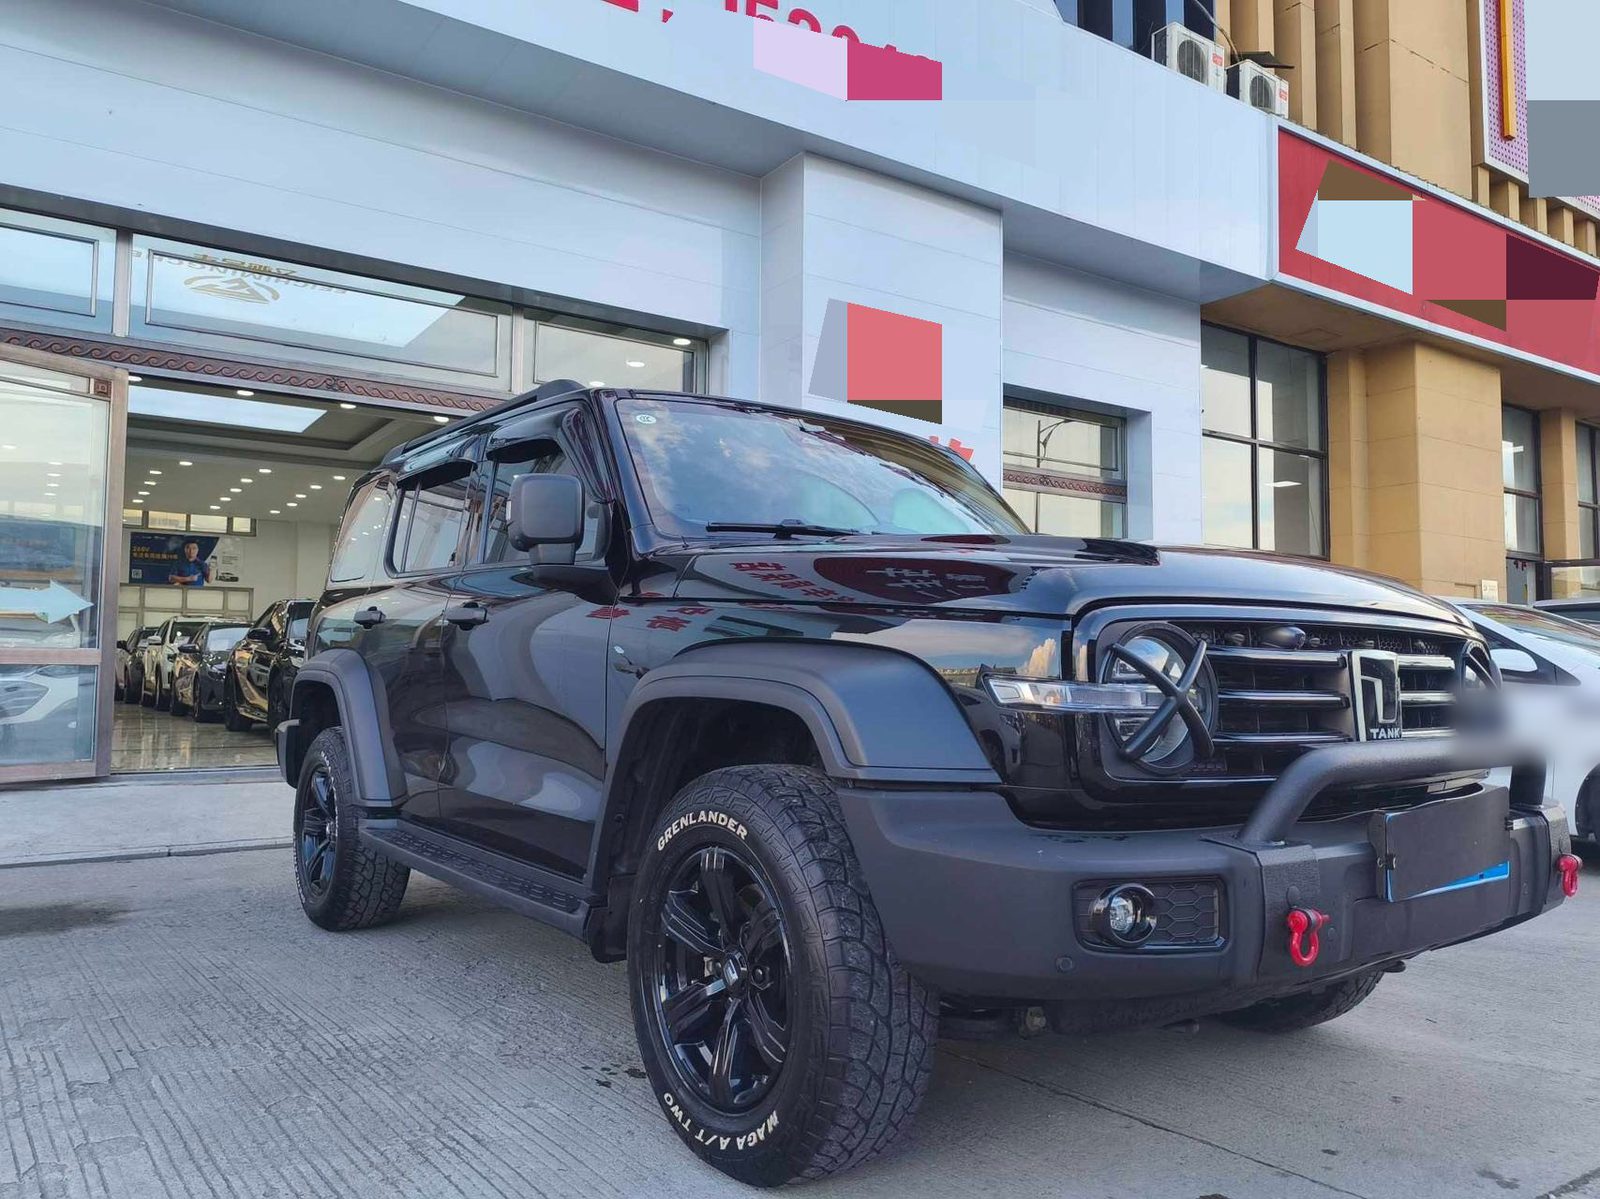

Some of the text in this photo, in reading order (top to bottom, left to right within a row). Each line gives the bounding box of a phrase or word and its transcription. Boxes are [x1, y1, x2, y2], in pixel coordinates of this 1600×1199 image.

[1369, 727, 1401, 739] TANK
[657, 810, 748, 851] GRENLANDER
[663, 1092, 779, 1150] MAGA A/T TWO
